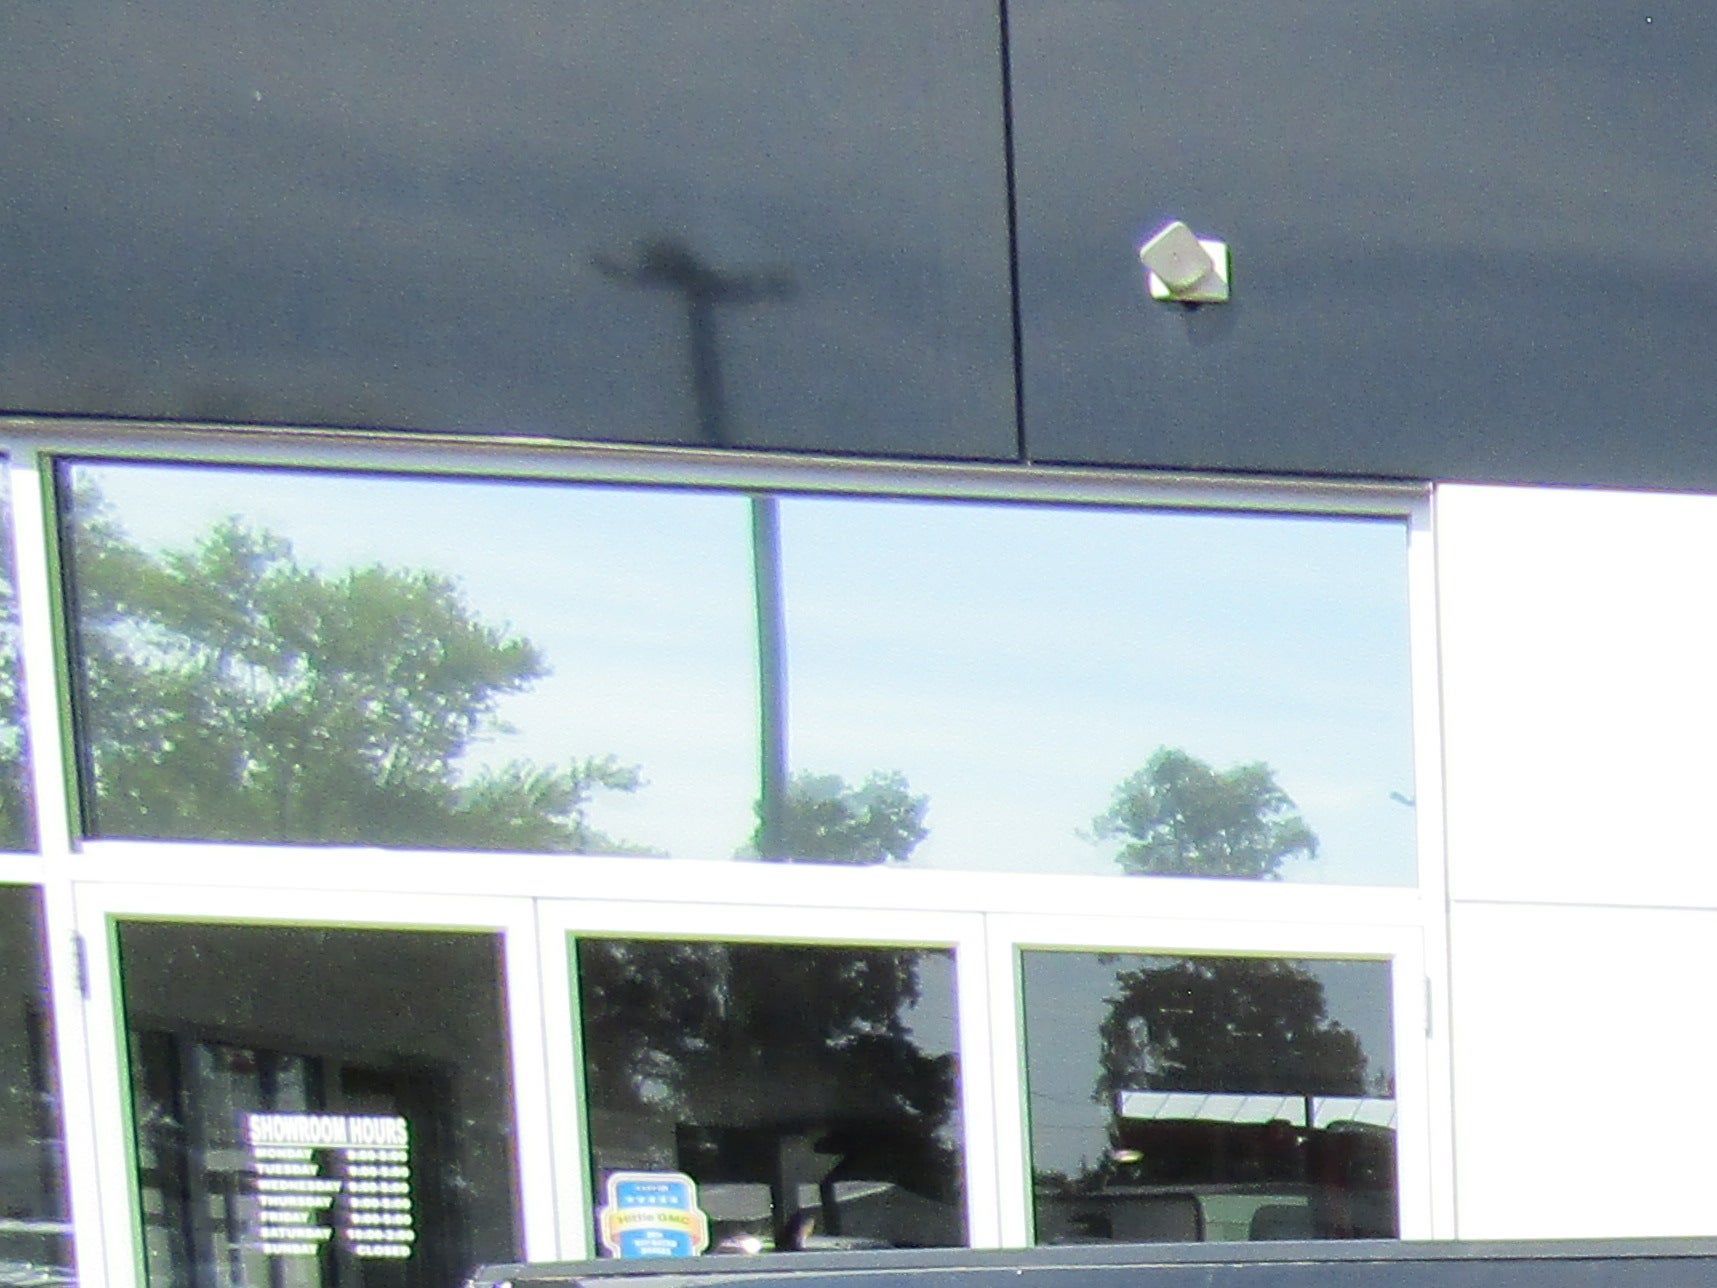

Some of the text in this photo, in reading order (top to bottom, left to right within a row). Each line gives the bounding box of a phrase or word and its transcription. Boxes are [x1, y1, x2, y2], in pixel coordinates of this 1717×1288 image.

[250, 1113, 409, 1145] SHOWROOM HOURS
[254, 1147, 313, 1160] MONDAY
[254, 1163, 320, 1176] TUESDAY
[256, 1179, 343, 1192] WEDNESDAY
[258, 1195, 333, 1207] THURSDAY
[259, 1211, 310, 1224] FRIDAY
[259, 1226, 333, 1240] SATURDAY
[261, 1242, 412, 1258] SUNDAY CLOSED
